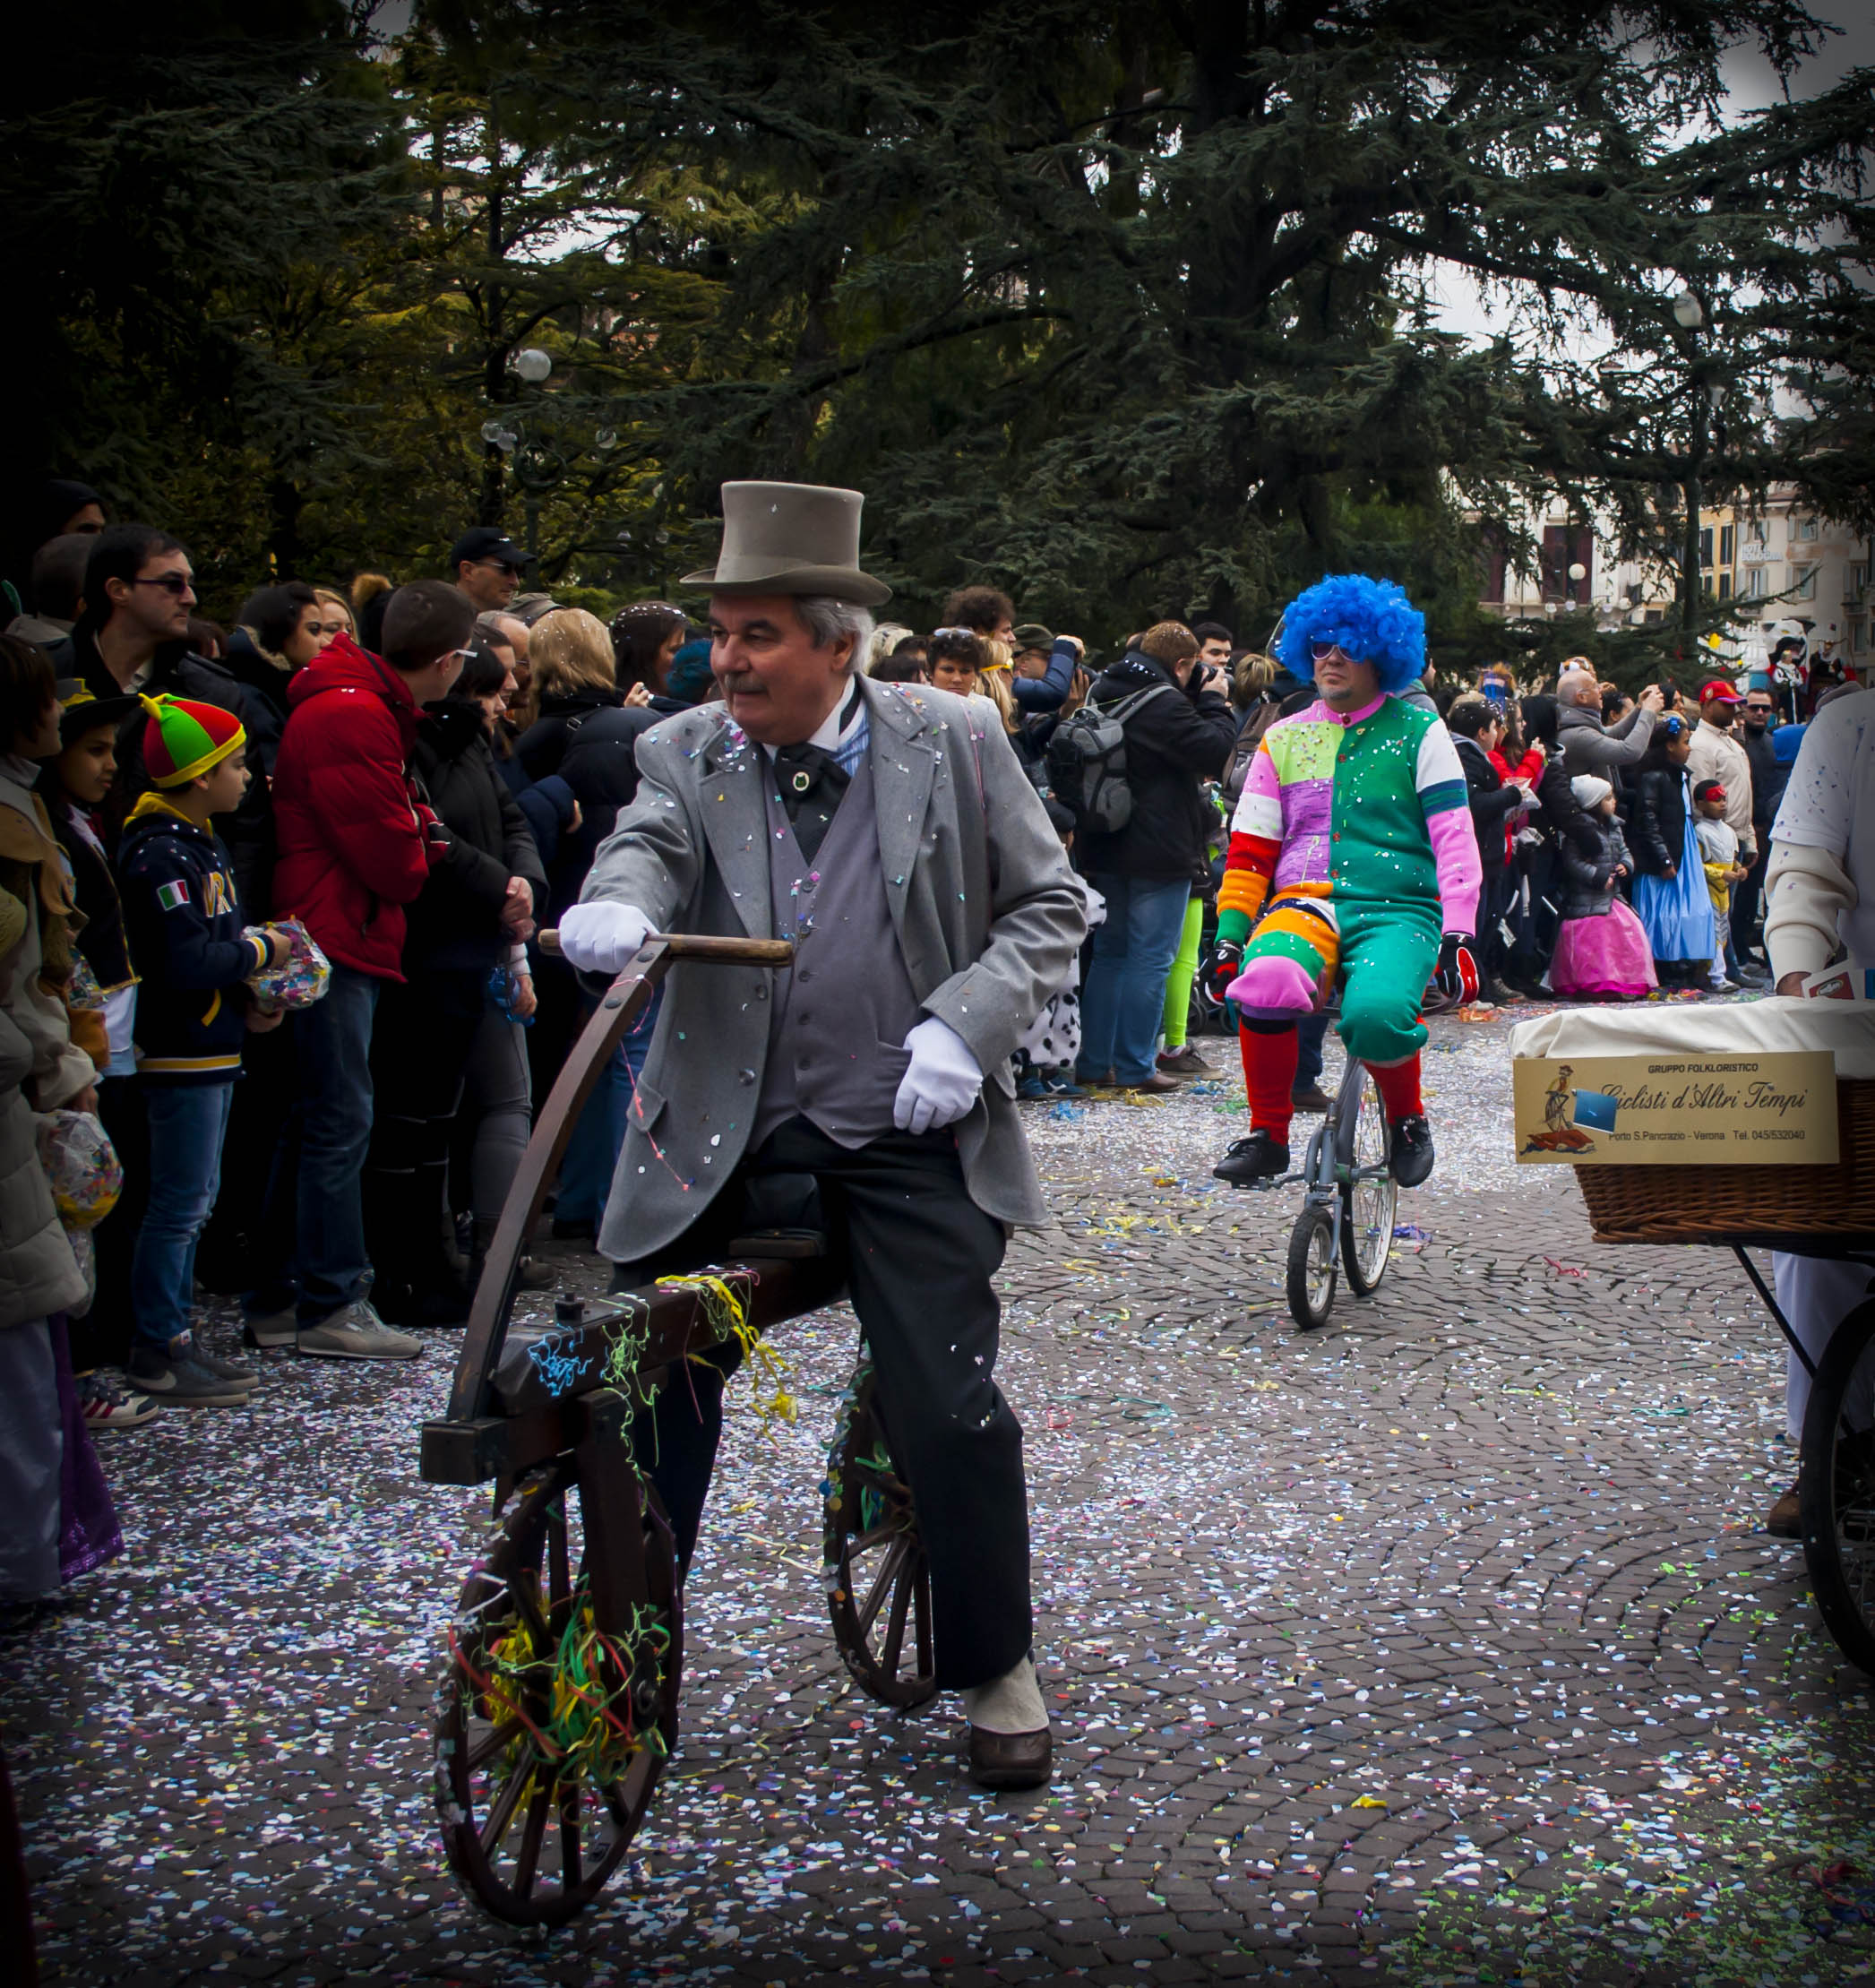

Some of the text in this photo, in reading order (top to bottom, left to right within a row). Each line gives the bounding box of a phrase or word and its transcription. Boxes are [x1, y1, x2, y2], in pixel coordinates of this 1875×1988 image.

[1648, 1063, 1759, 1073] GRUPPO FOLKLORISTICO
[1672, 1082, 1741, 1109] d'Altri
[1743, 1081, 1808, 1117] Tempi
[1608, 1132, 1631, 1140] Porto
[1693, 1131, 1725, 1140] Verona
[1733, 1130, 1749, 1140] Tel.
